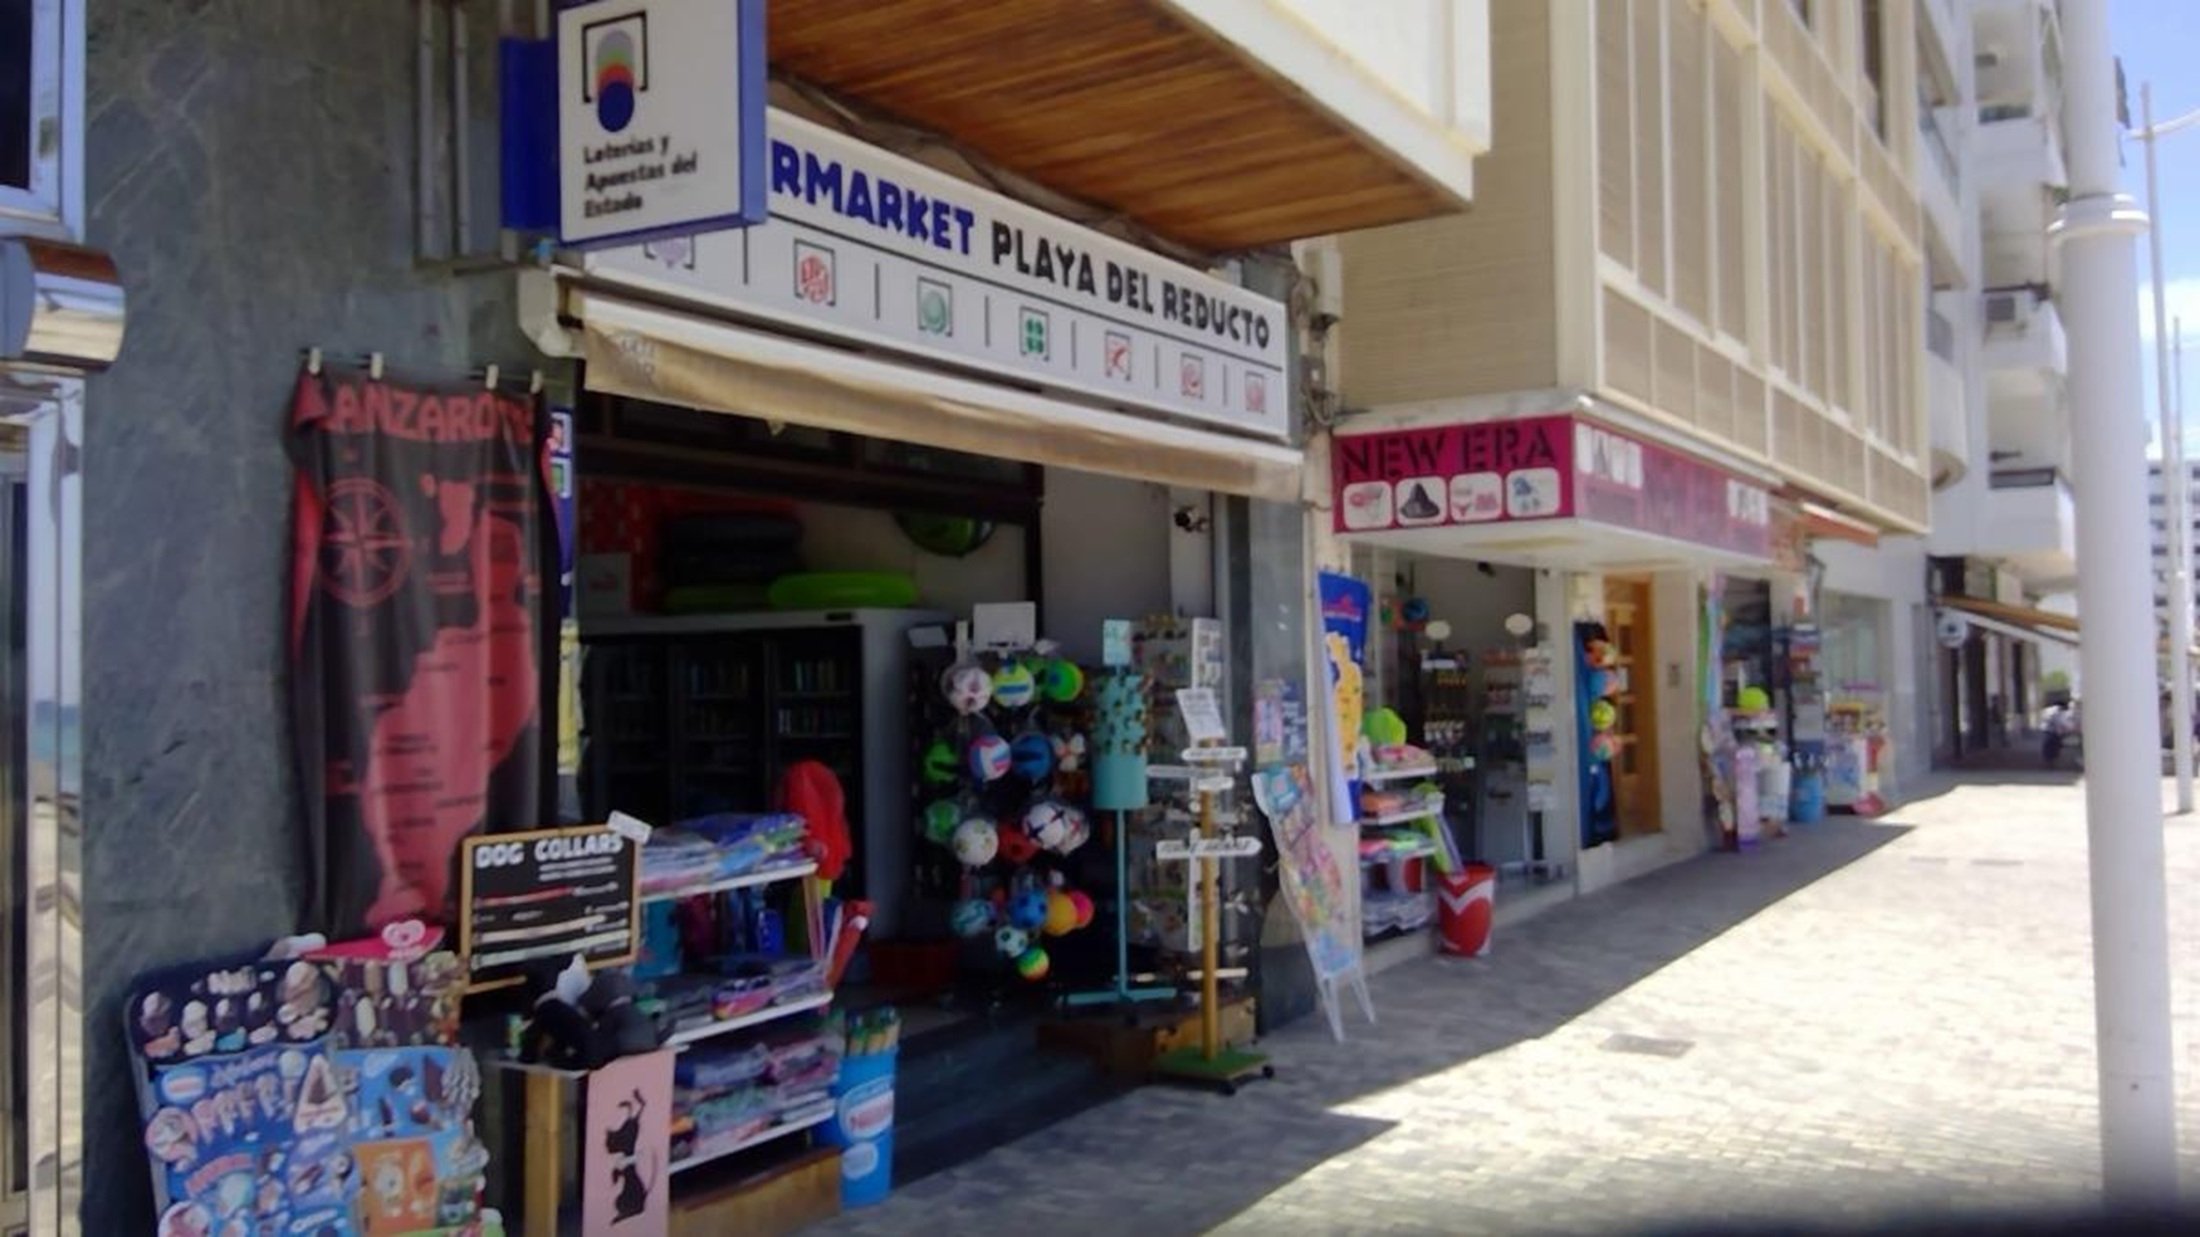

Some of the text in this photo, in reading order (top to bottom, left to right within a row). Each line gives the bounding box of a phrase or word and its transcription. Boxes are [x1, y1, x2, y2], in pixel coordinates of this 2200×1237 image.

[585, 150, 698, 193] Apuestas del
[584, 192, 643, 217] Estado
[772, 140, 1271, 350] RMARKET PLAYA DEL REDUCTO
[1342, 432, 1445, 481] NEW
[1463, 425, 1556, 471] ERA
[475, 833, 623, 868] DOG COLLARS
